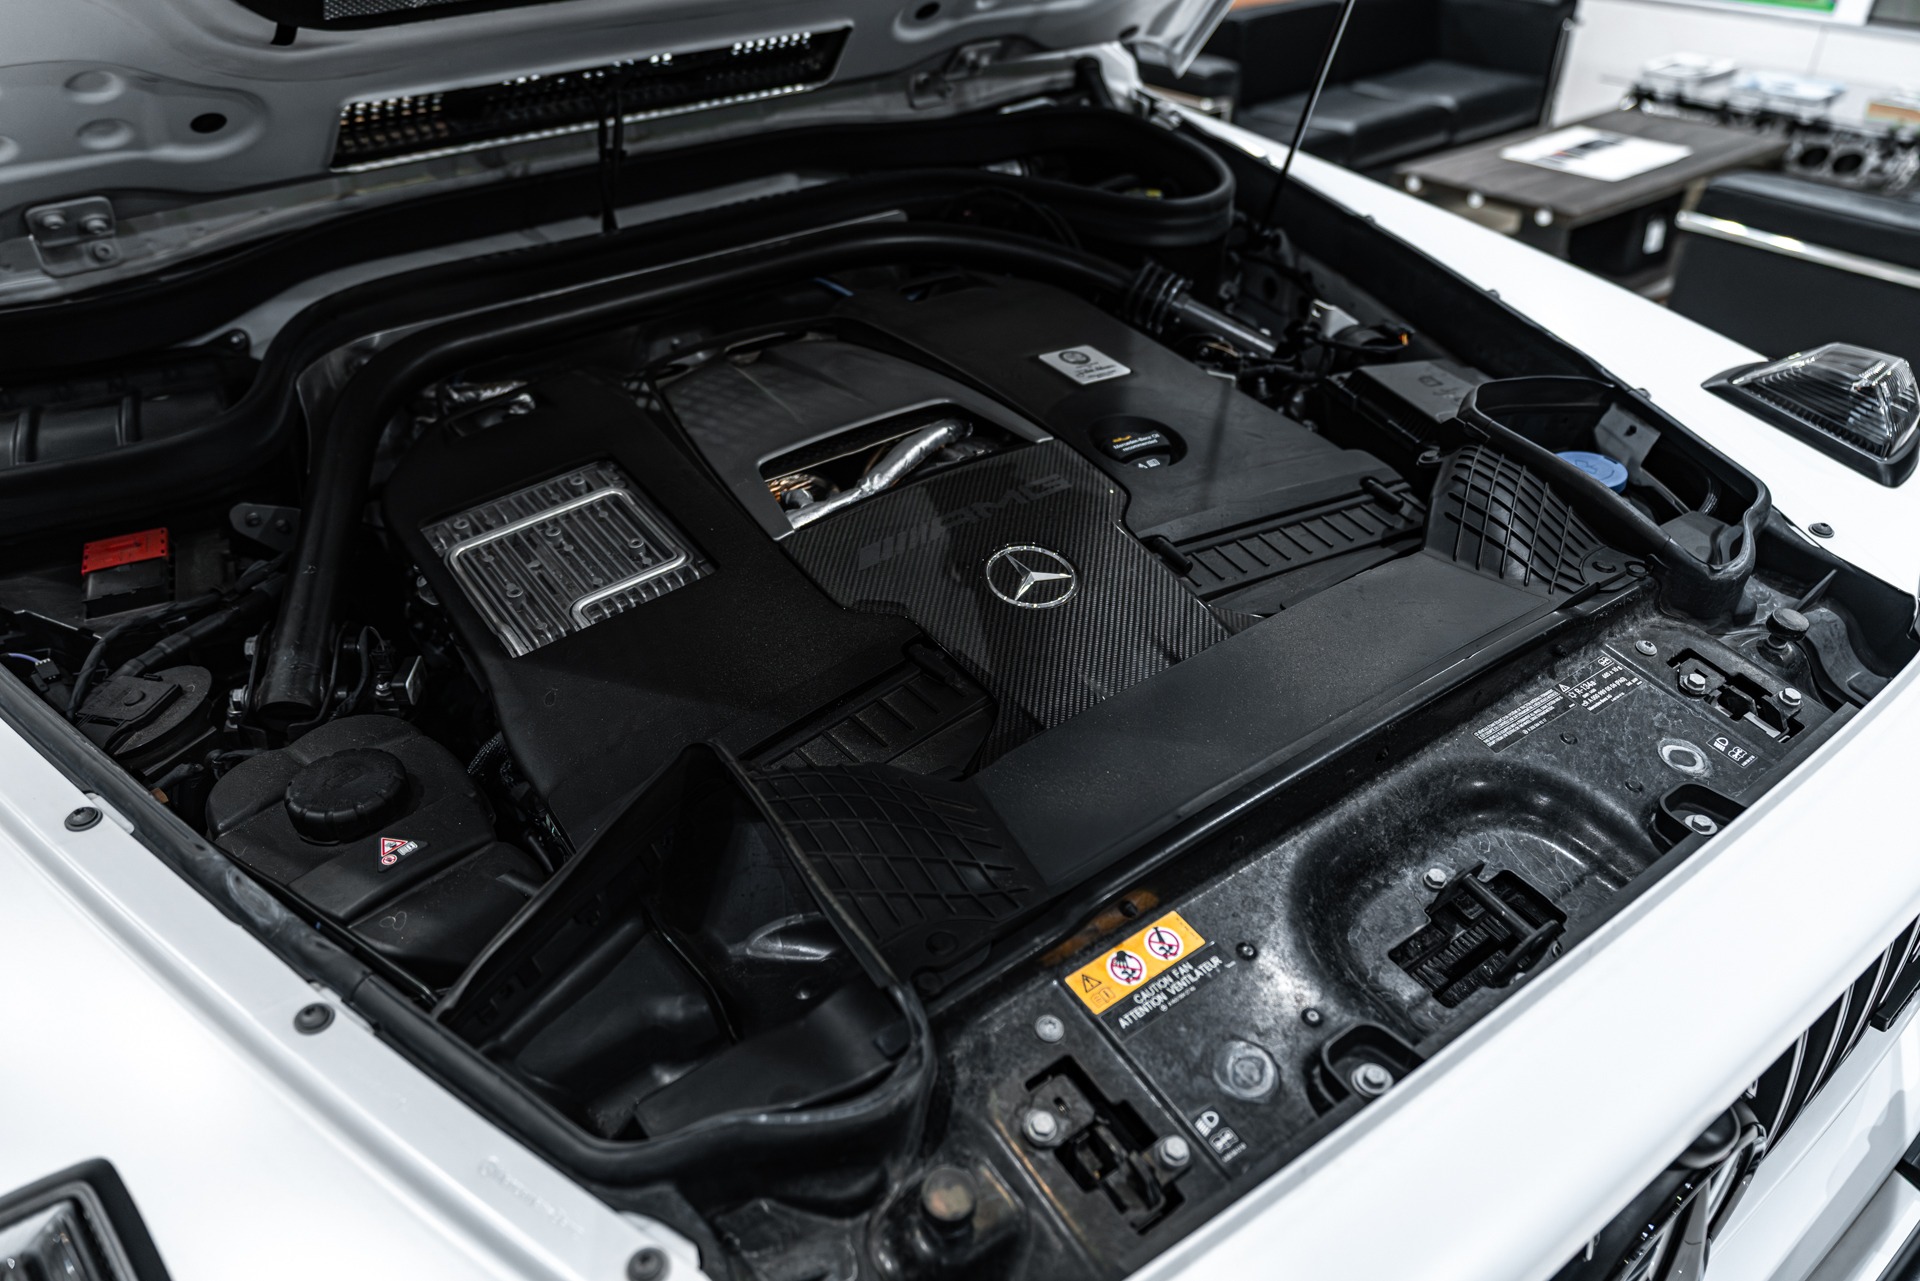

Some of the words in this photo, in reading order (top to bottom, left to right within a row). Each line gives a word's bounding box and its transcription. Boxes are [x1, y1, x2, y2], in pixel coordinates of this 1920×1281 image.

[1574, 680, 1597, 695] R-134a
[1118, 991, 1168, 1029] ATTENTION
[1167, 955, 1222, 995] VENTILATEUR
[1133, 974, 1173, 1004] CAUTION
[1171, 961, 1194, 979] FAN
